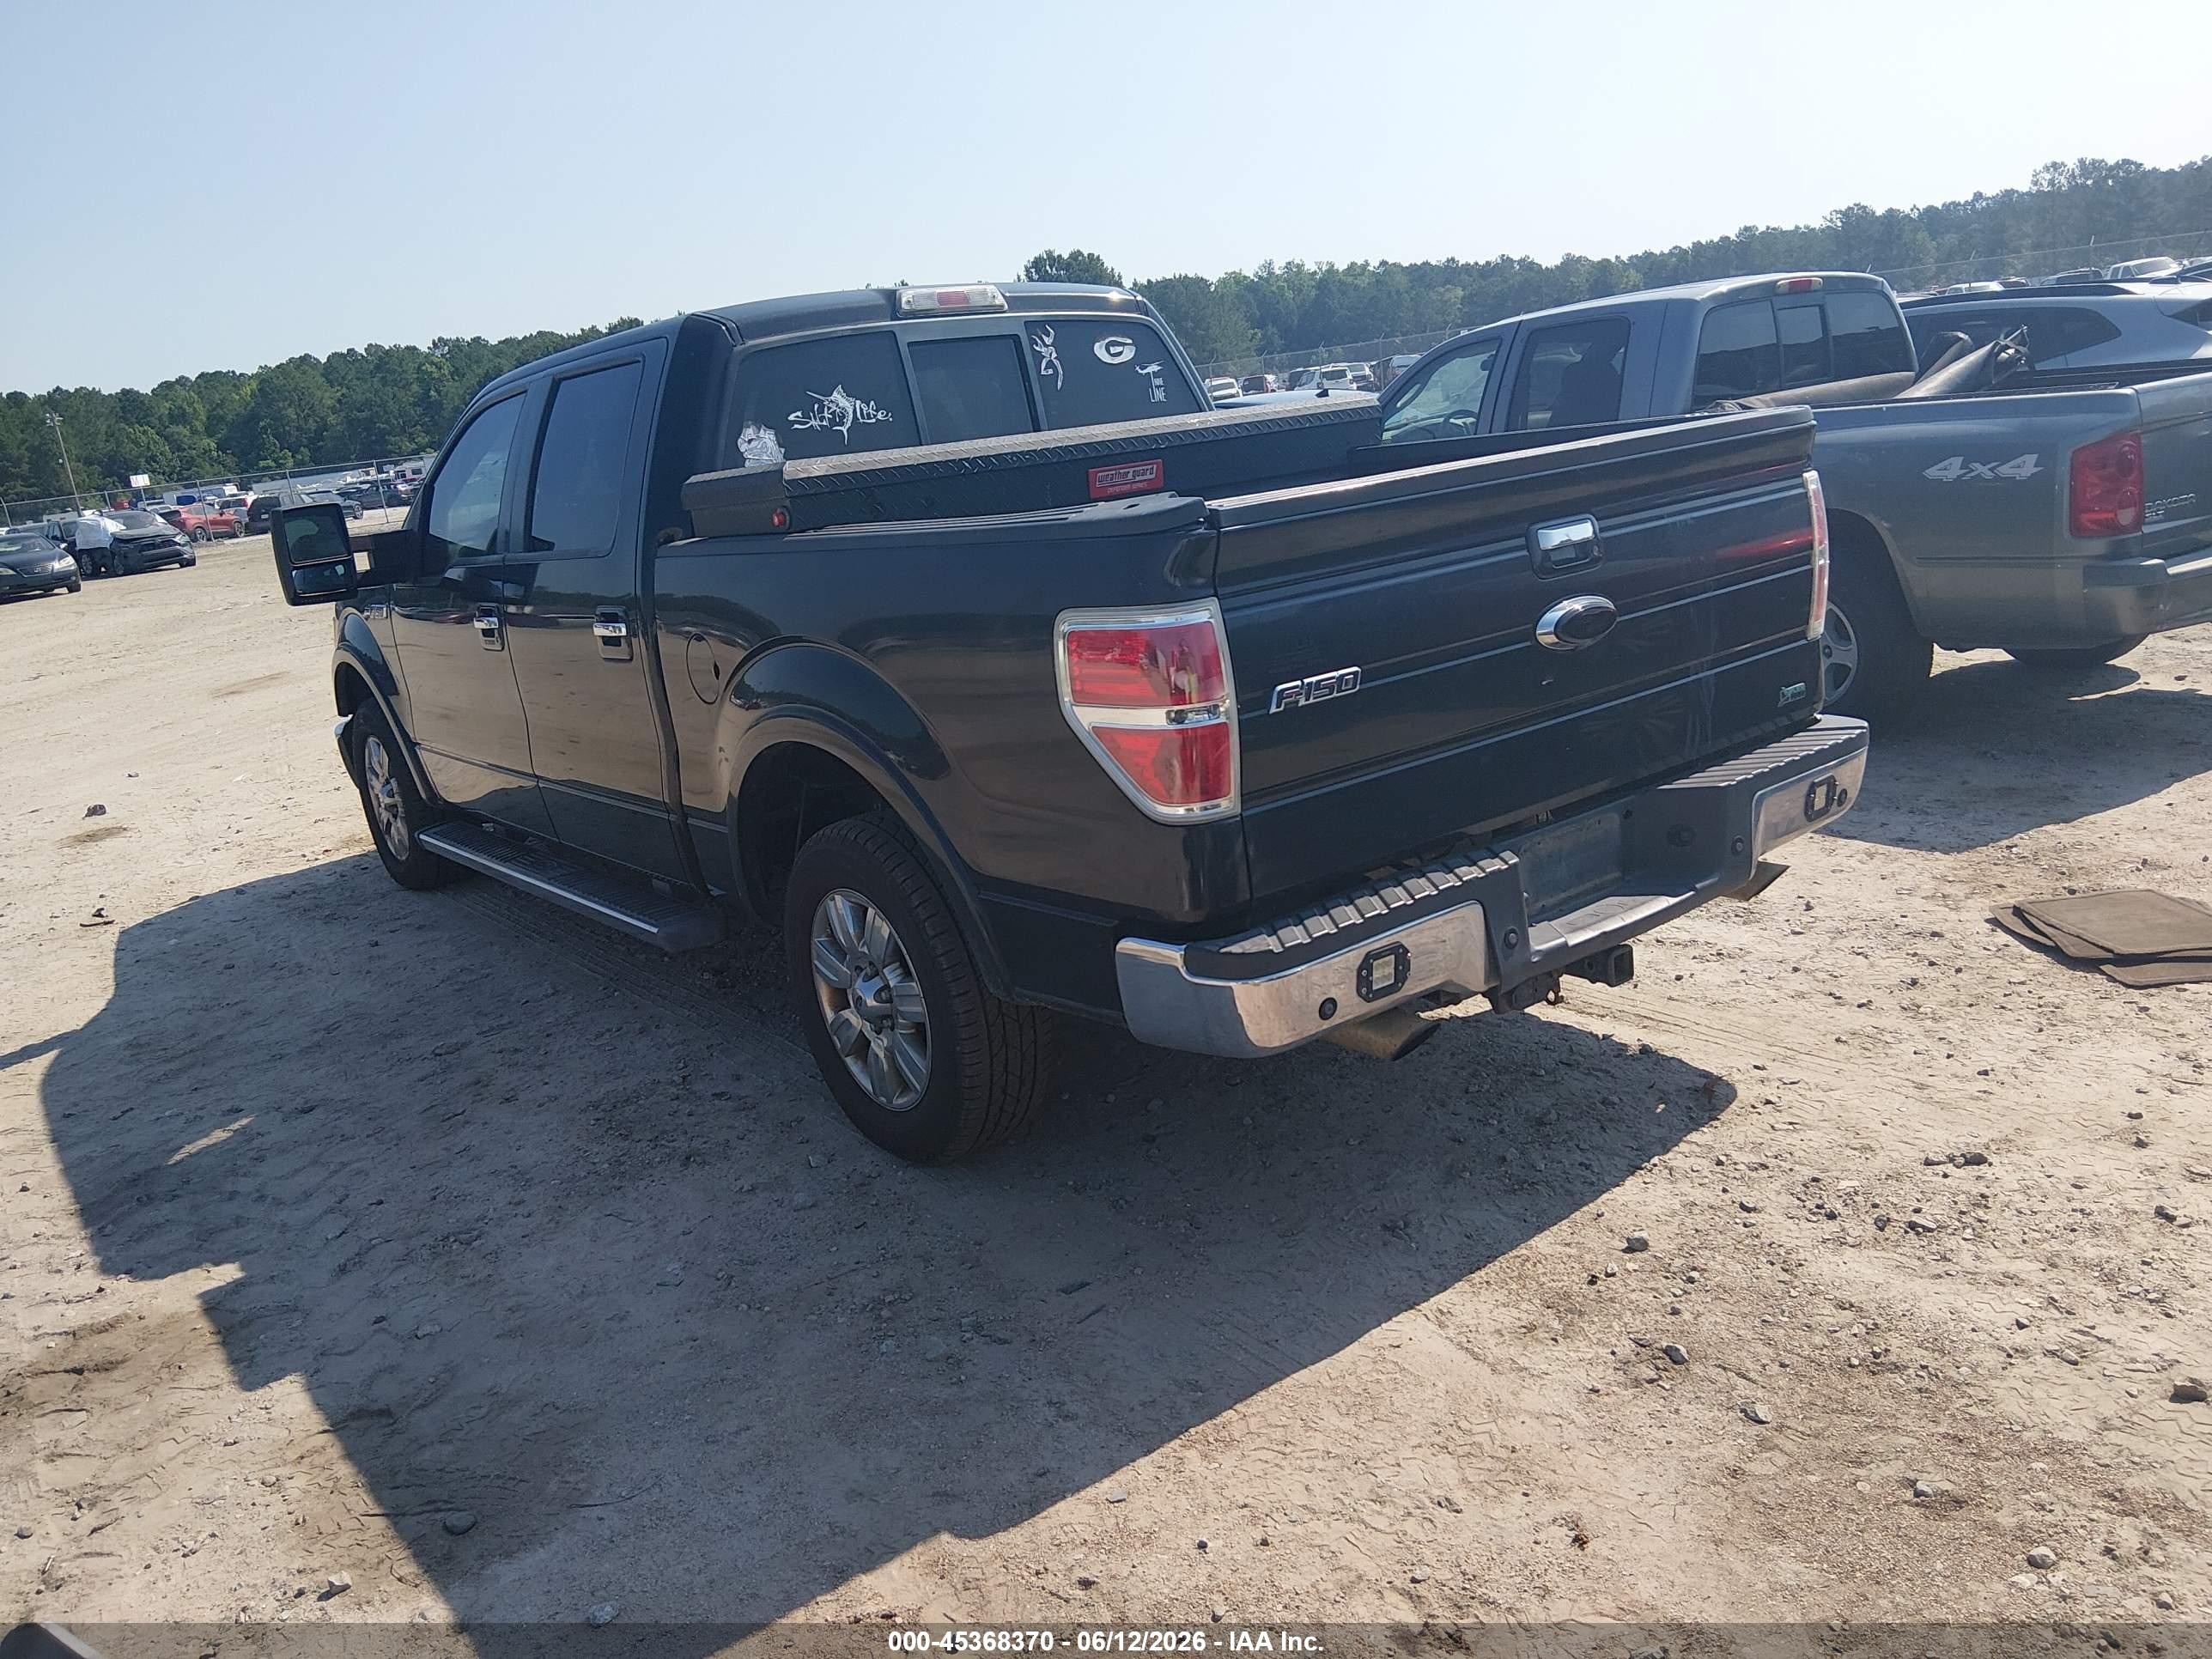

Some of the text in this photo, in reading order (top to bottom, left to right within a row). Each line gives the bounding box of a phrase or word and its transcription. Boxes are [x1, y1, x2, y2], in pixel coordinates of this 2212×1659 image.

[1148, 386, 1168, 403] LINE
[1098, 466, 1155, 483] weather guard
[1922, 453, 2045, 482] 4x4
